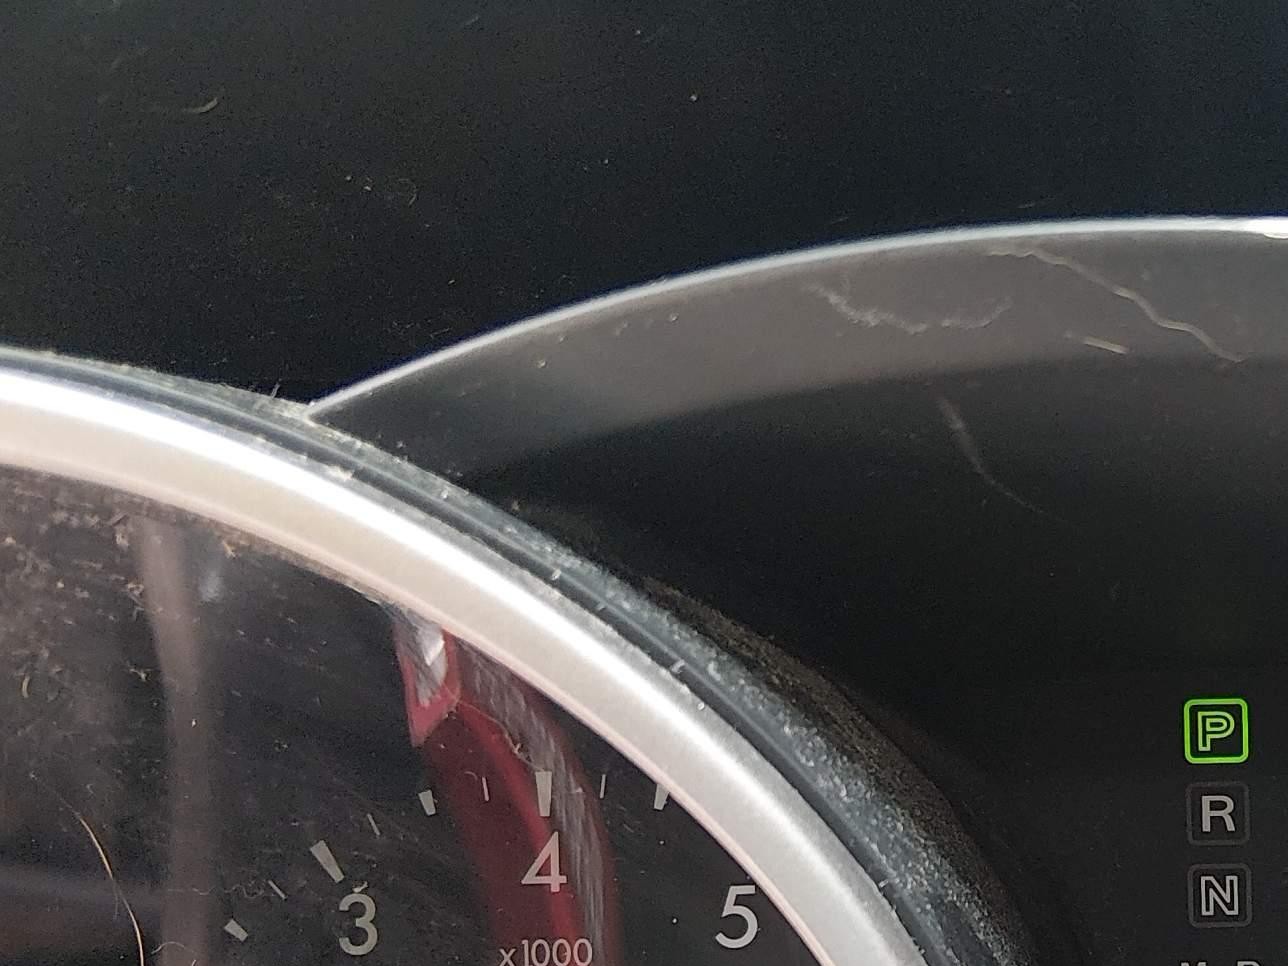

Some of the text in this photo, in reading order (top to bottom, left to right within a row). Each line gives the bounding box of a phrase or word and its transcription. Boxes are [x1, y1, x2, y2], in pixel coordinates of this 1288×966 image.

[1197, 710, 1235, 752] P
[1201, 795, 1236, 833] R
[521, 831, 567, 893] 4
[715, 885, 759, 949] 5
[1200, 875, 1239, 916] N
[338, 895, 378, 956] 3
